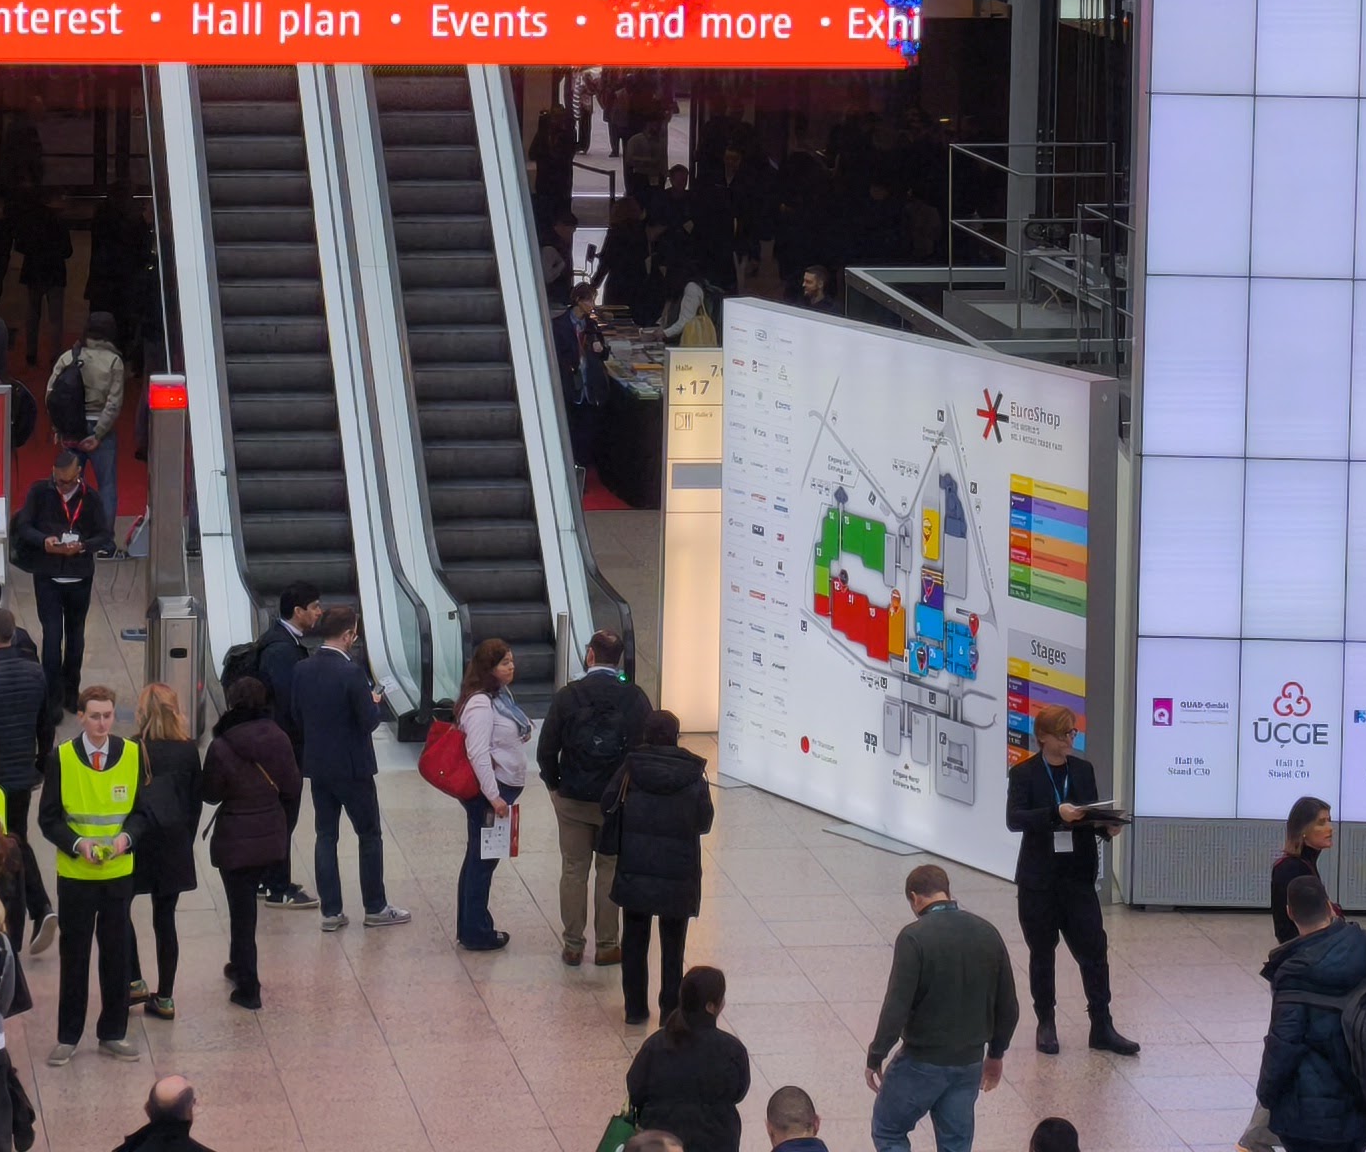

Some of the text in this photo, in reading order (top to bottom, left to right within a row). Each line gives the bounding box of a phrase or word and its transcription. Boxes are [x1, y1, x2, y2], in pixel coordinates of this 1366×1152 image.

[191, 1, 263, 36] Hall
[279, 2, 360, 44] plan
[431, 3, 548, 38] Events
[615, 6, 684, 39] and
[701, 14, 792, 39] more
[847, 6, 923, 41] Exhi
[1010, 401, 1061, 429] EuroShop
[1031, 639, 1067, 665] Stages
[1174, 756, 1192, 765] Hall
[1276, 759, 1293, 767] Hall
[1168, 767, 1192, 776] Stand
[1268, 769, 1292, 779] Stand
